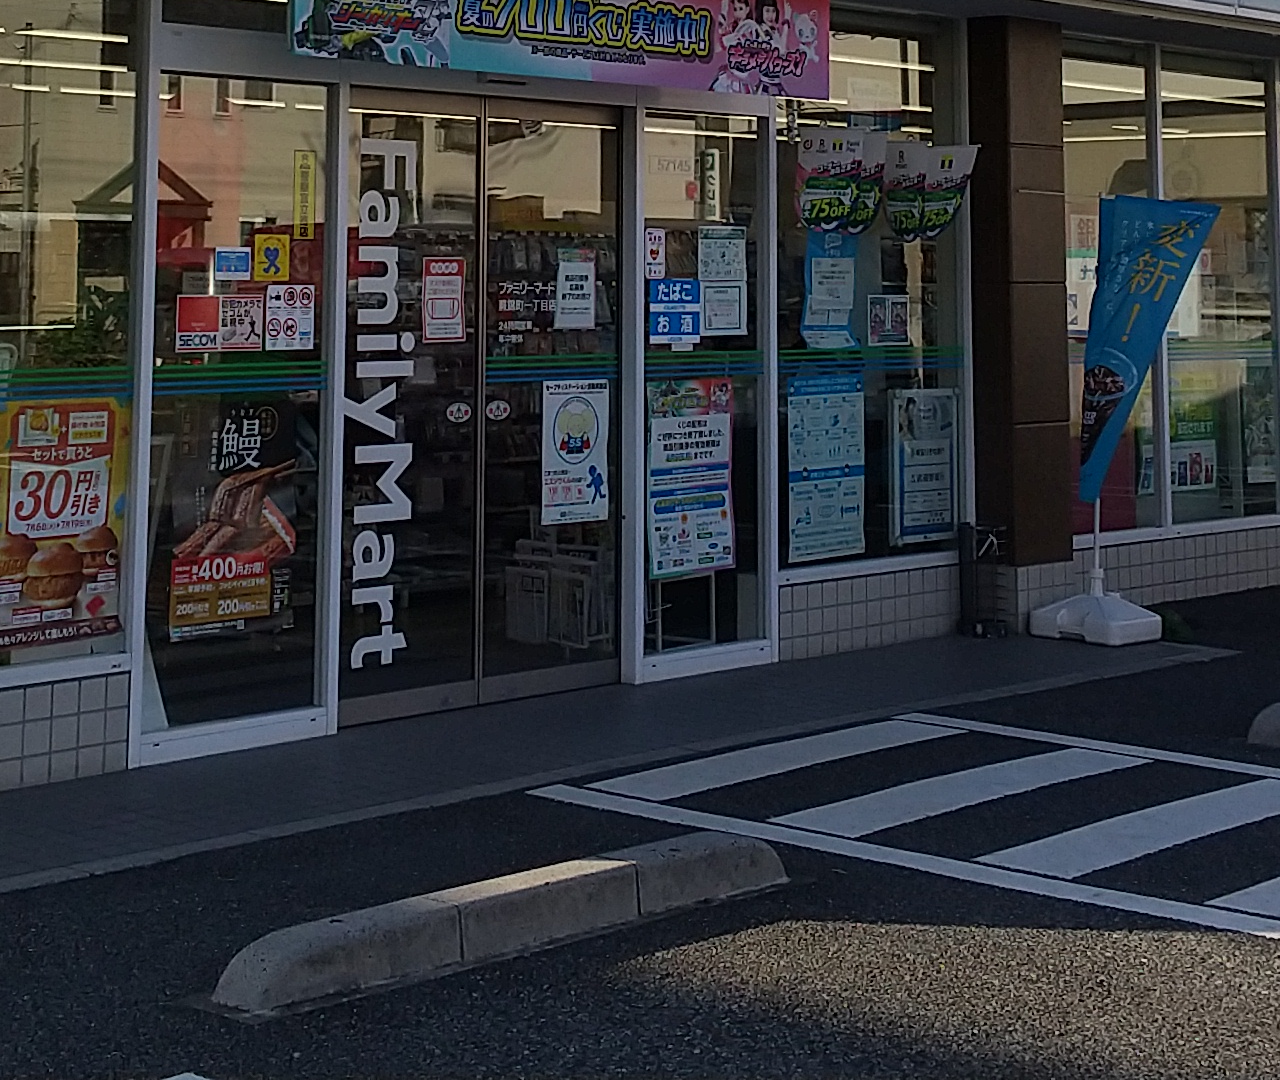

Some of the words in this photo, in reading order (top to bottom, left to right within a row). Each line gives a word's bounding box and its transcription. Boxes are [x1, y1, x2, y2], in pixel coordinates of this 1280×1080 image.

[498, 281, 556, 296] ファミリーマート
[657, 282, 693, 301] たばこ
[178, 334, 217, 347] SECOM
[344, 138, 417, 670] FamilyMart
[33, 446, 94, 462] セットで買うと
[218, 418, 262, 472] 鰻
[14, 469, 73, 522] 30
[74, 470, 95, 493] 円
